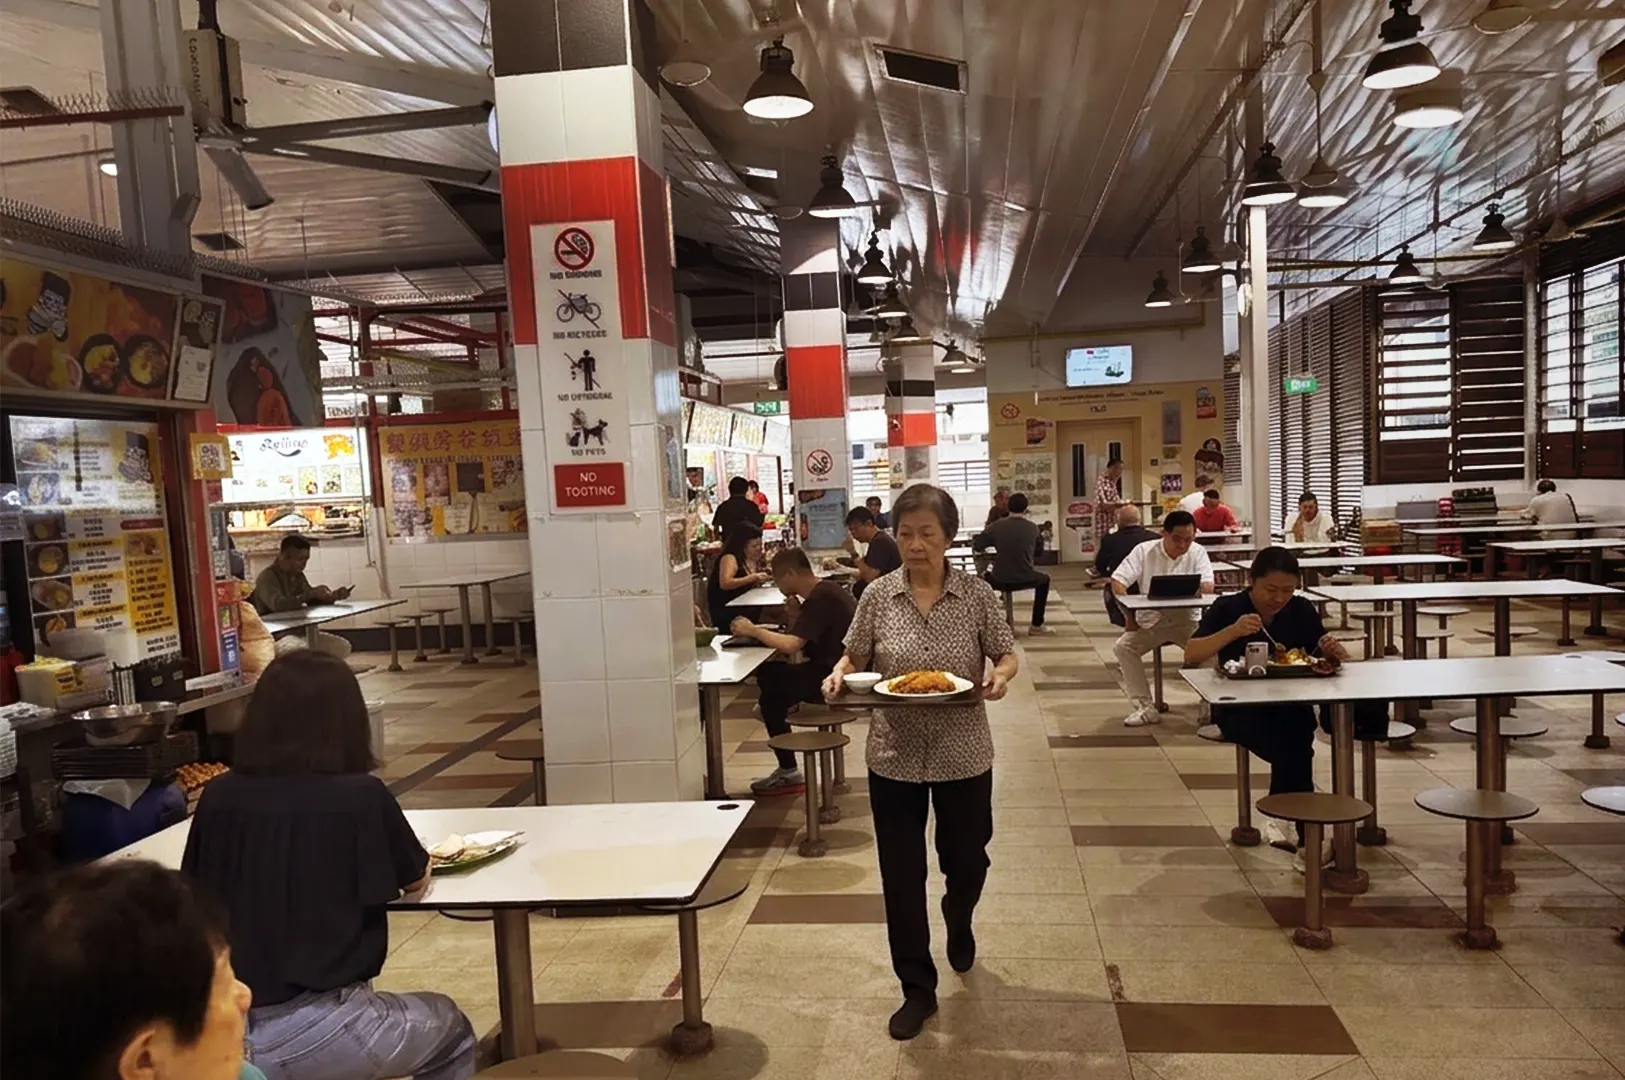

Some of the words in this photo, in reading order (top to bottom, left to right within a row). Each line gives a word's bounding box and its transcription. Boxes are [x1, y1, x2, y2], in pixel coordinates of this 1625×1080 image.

[585, 447, 606, 456] PETS
[579, 472, 597, 482] NO
[565, 485, 616, 497] TOOTING
